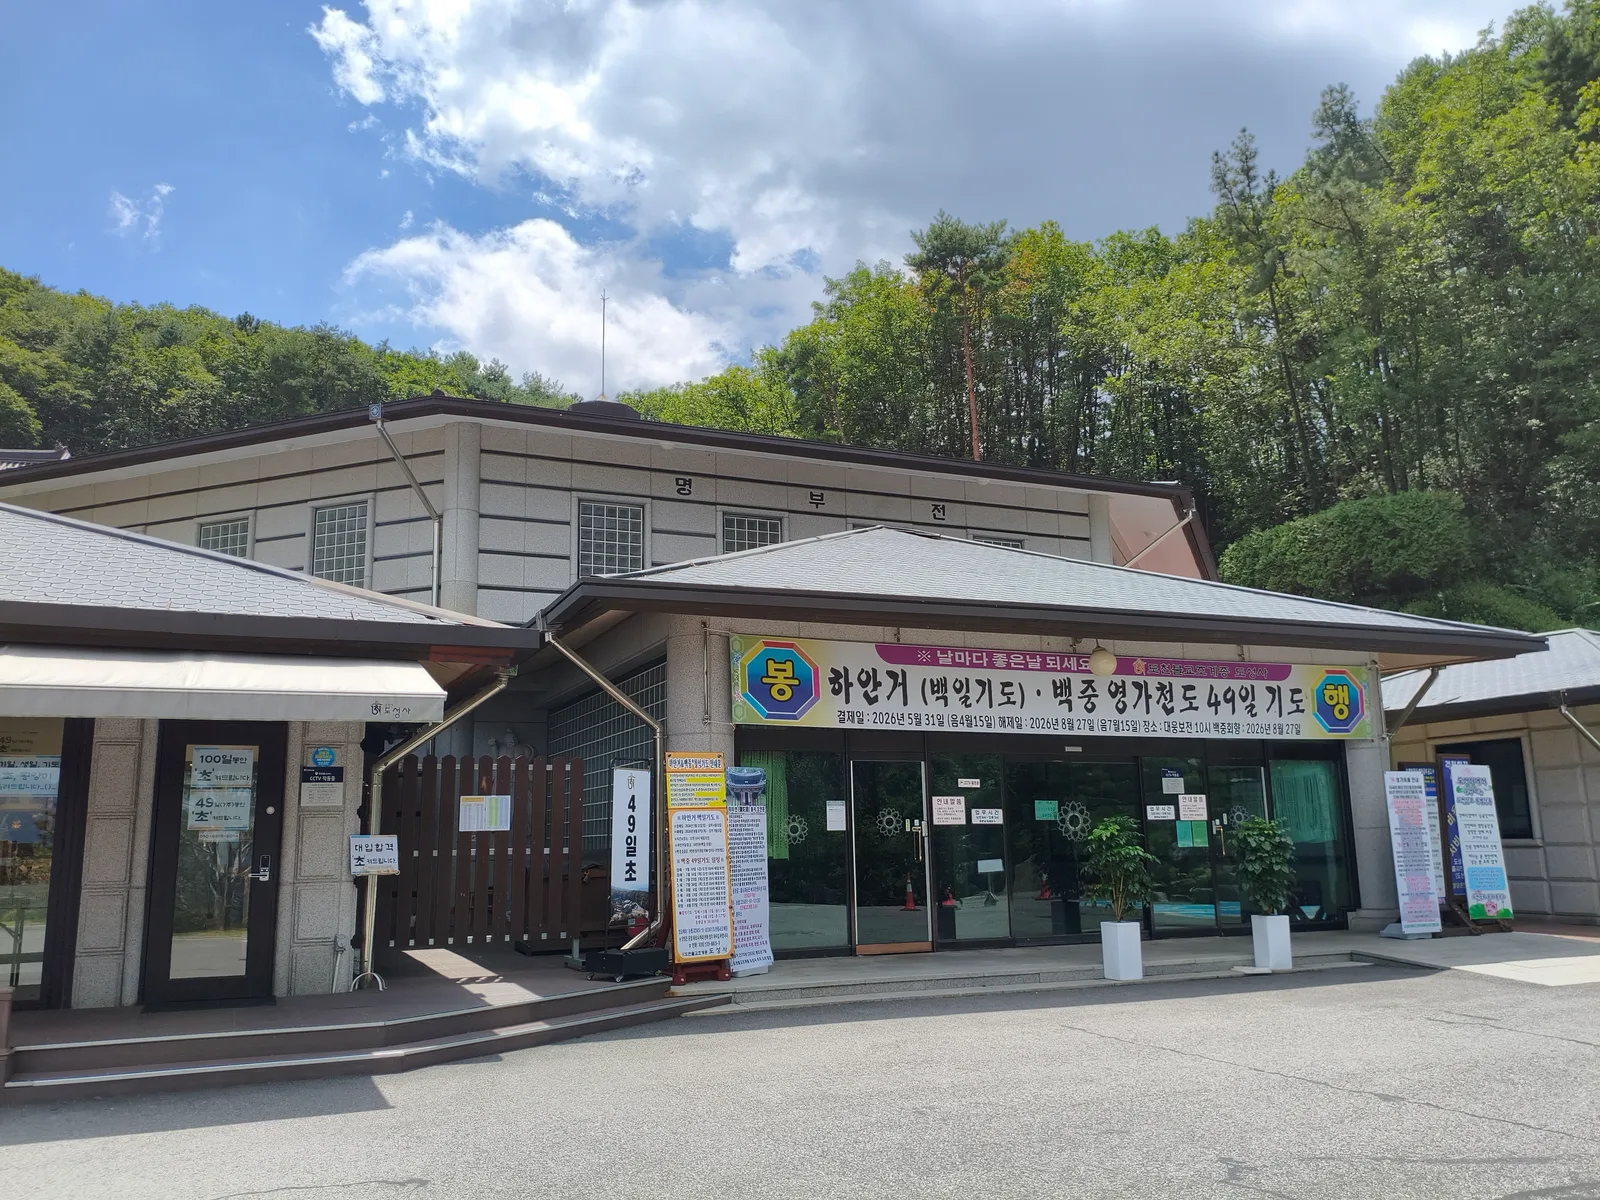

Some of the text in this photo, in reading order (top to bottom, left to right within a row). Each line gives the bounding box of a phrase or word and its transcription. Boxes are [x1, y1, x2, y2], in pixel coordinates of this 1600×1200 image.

[936, 650, 1090, 671] 날마다 좋은날 되세요
[1235, 667, 1268, 679] 도성사
[762, 658, 801, 702] 봉
[828, 666, 909, 707] 하안거
[921, 676, 1025, 709] (백일기도)
[1323, 683, 1349, 720] 행
[872, 712, 905, 726] 2026년
[908, 713, 922, 726] 5월
[925, 714, 945, 727] 31일
[947, 714, 996, 729] (음4월15일)
[1029, 717, 1059, 731] 2026년
[1061, 718, 1074, 732] 8월
[1076, 719, 1095, 732] 27일
[1097, 719, 1141, 733] (음7월15일)
[1164, 721, 1193, 733] 대웅보전
[1195, 722, 1211, 734] 10시
[1245, 723, 1271, 735] 2026년
[1273, 724, 1284, 735] 8월
[1285, 724, 1301, 736] 27일
[354, 843, 394, 853] 대입합격
[624, 794, 638, 882] 49일초
